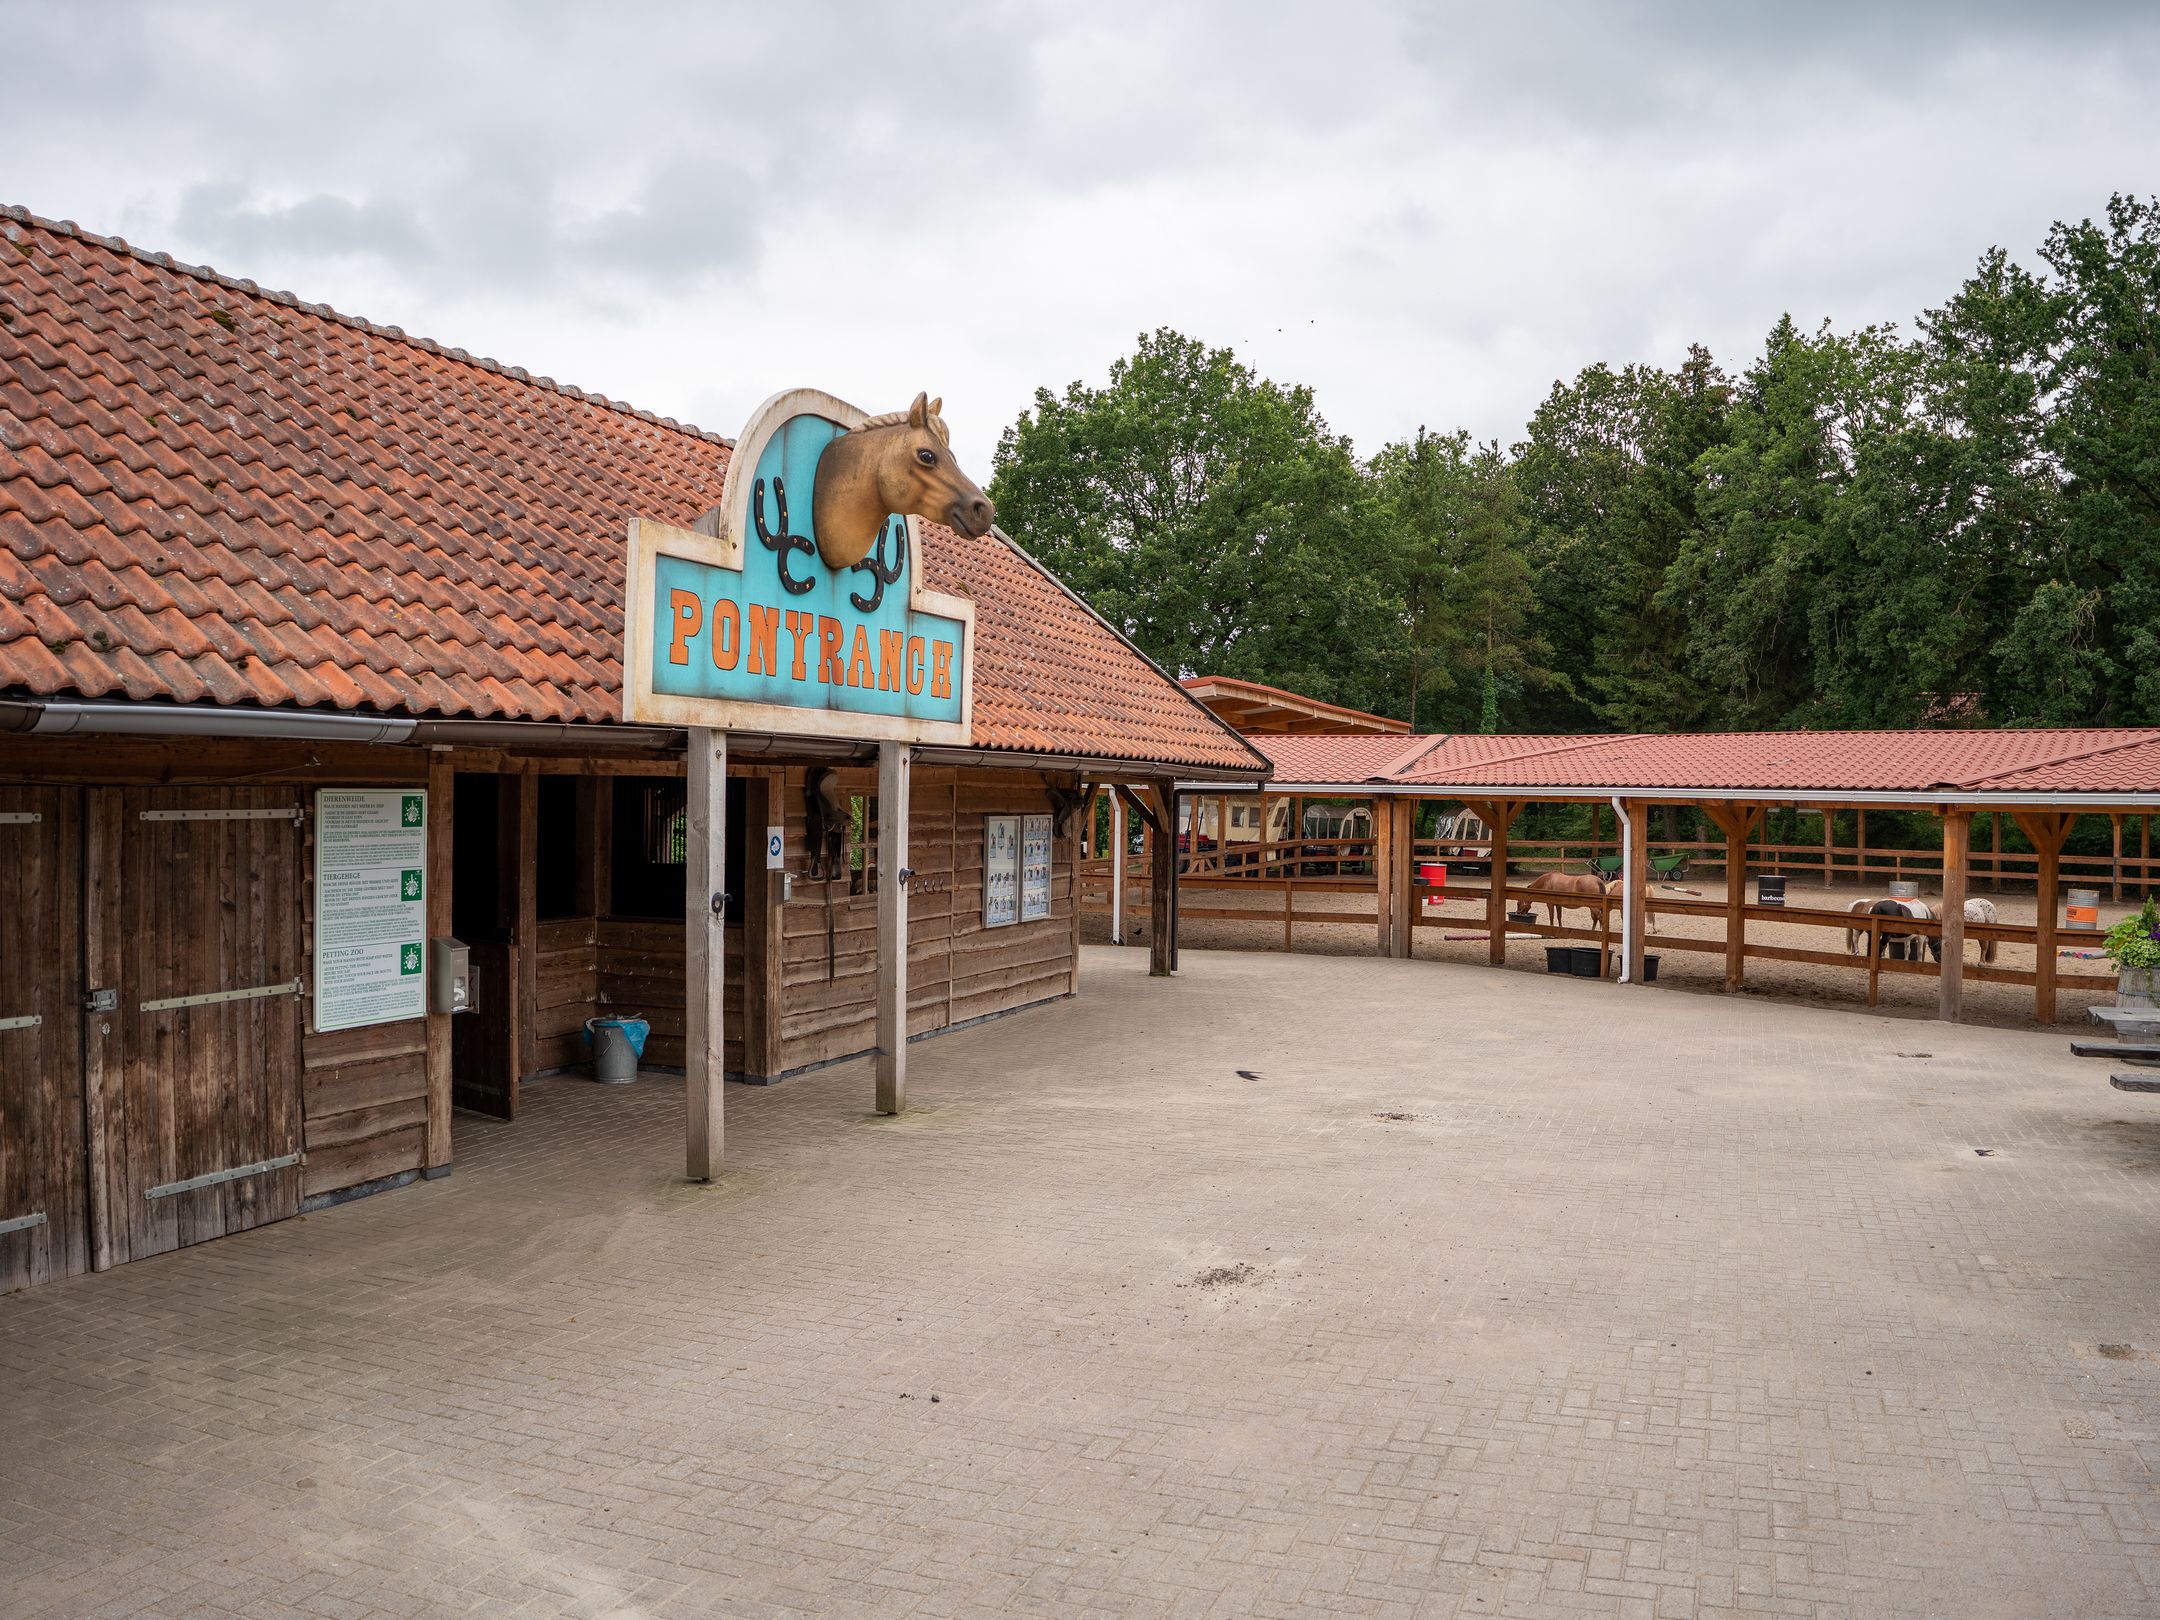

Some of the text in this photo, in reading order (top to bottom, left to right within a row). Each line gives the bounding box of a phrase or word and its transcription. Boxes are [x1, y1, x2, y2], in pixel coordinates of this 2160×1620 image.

[669, 587, 954, 699] PONYRANCH
[323, 872, 361, 880] TIERGEHEGE
[323, 950, 349, 958] PETTING
